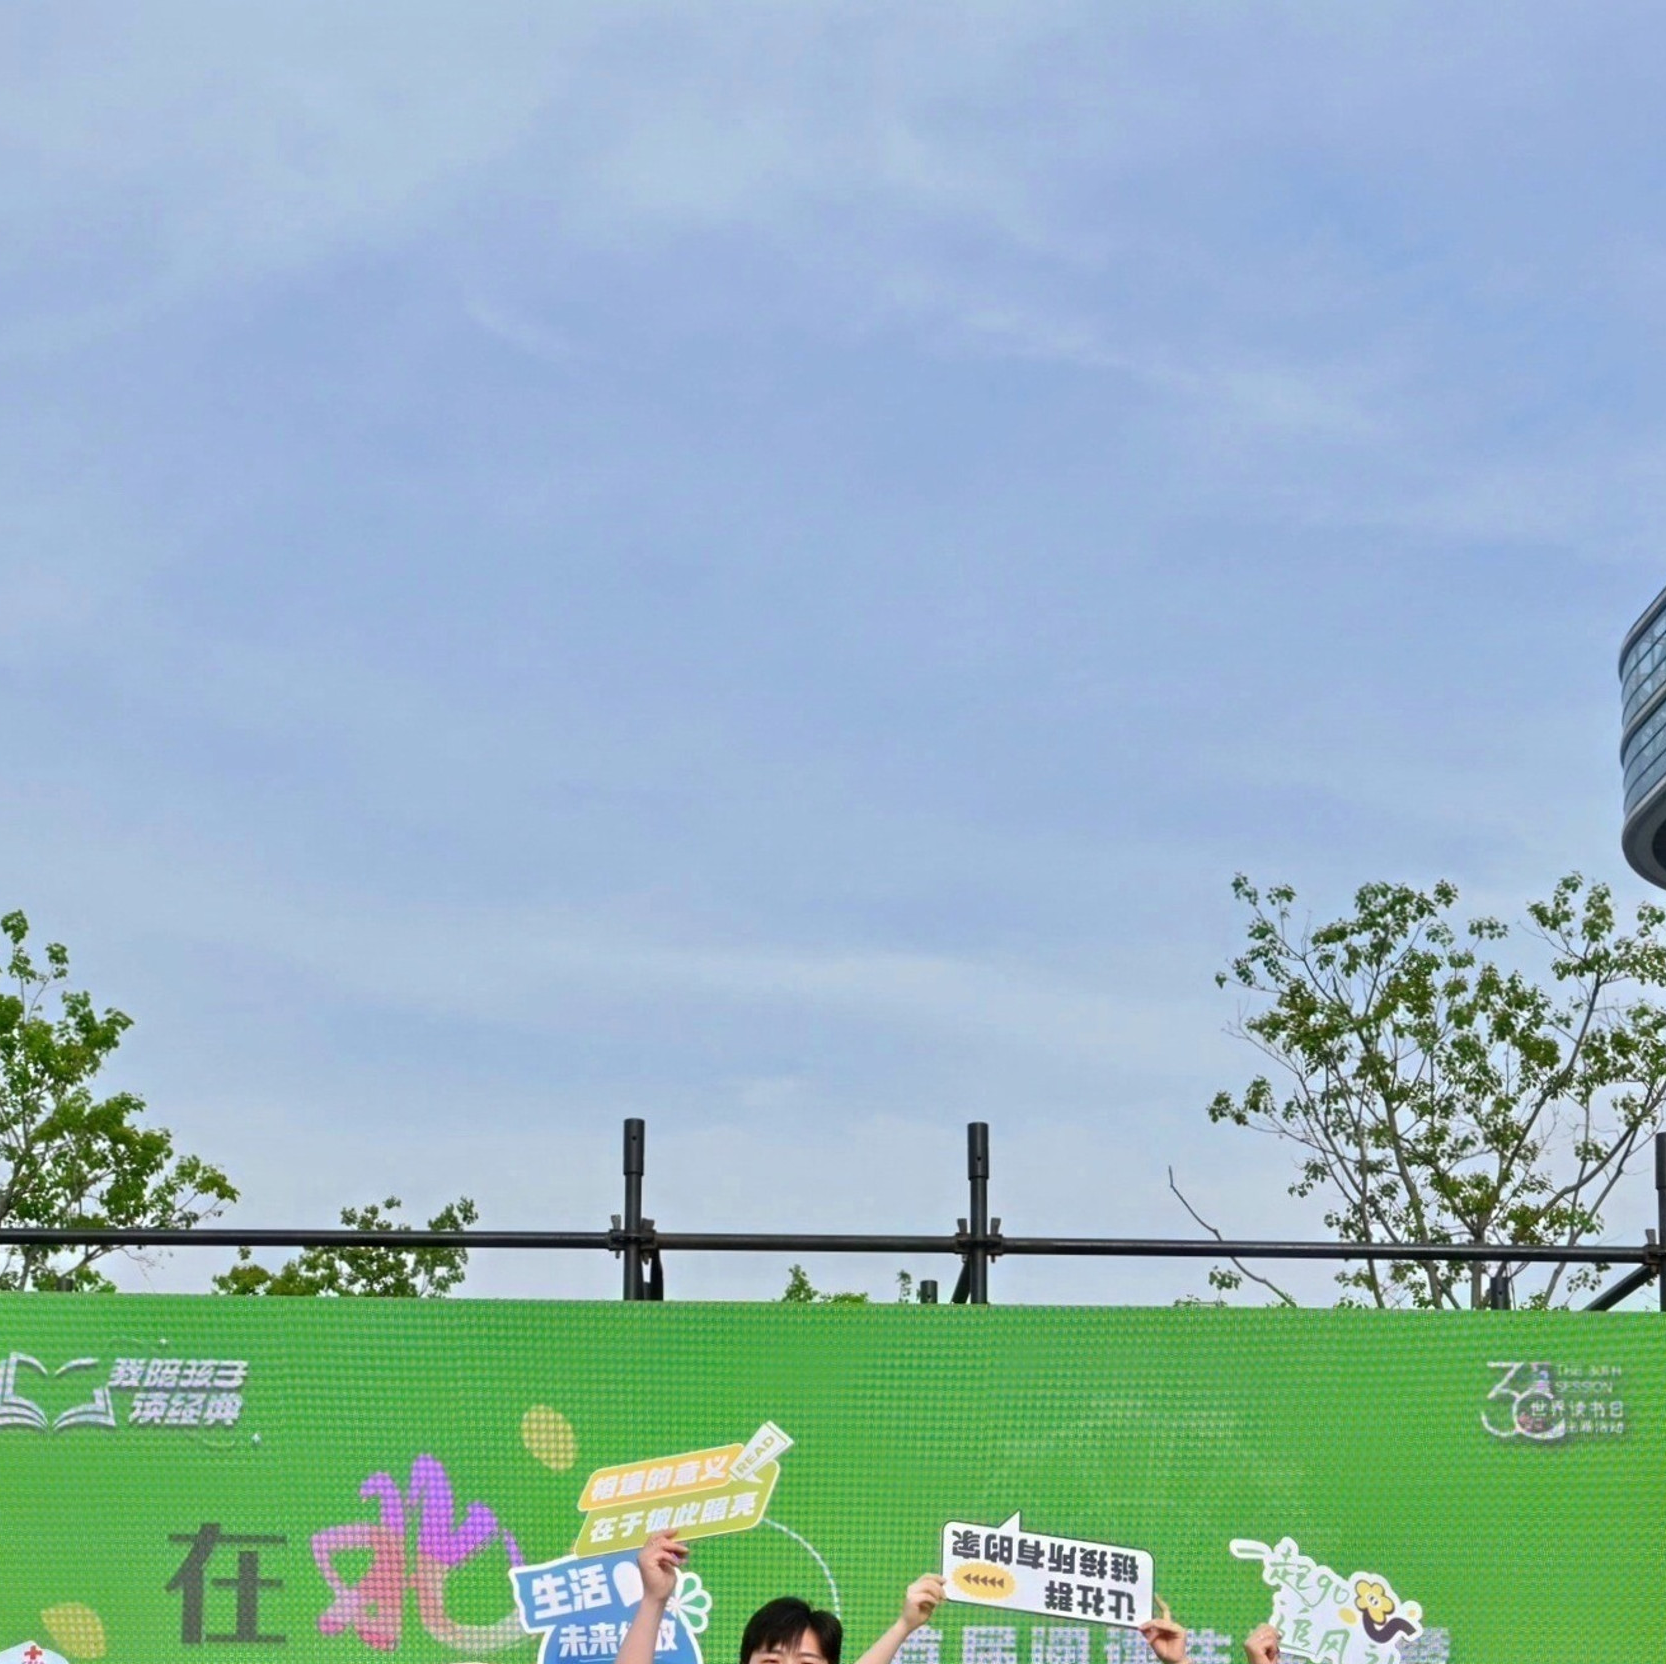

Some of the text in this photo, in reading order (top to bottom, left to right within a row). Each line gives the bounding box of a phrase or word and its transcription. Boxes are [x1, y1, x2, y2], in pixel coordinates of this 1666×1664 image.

[108, 1357, 248, 1388] 我陪孩子
[129, 1392, 243, 1425] 读经典
[735, 1435, 776, 1474] READ
[532, 1563, 612, 1621] 生活
[1043, 1579, 1137, 1622] 让社群
